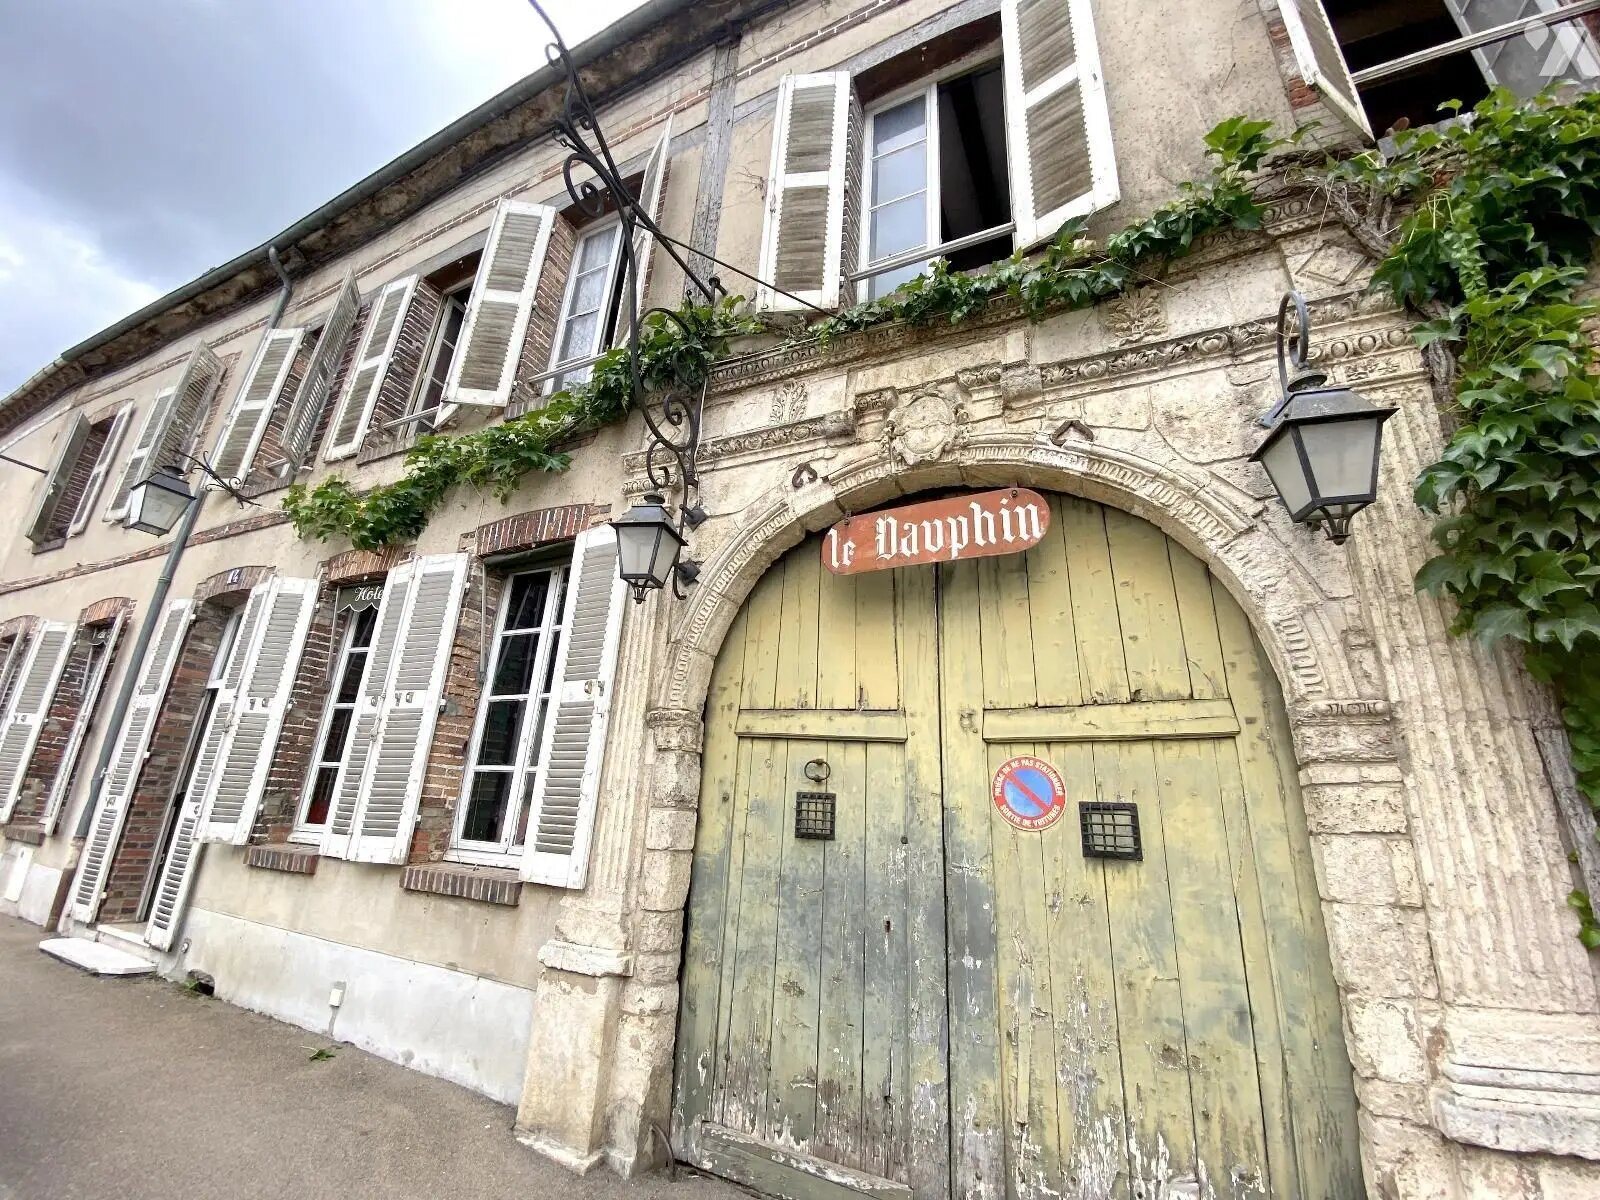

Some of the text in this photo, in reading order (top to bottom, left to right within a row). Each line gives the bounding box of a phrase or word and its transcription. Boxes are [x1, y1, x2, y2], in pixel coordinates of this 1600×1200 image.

[355, 586, 384, 601] Hôte
[1001, 805, 1021, 824] SORTIE
[1033, 804, 1061, 827] VOITURES
